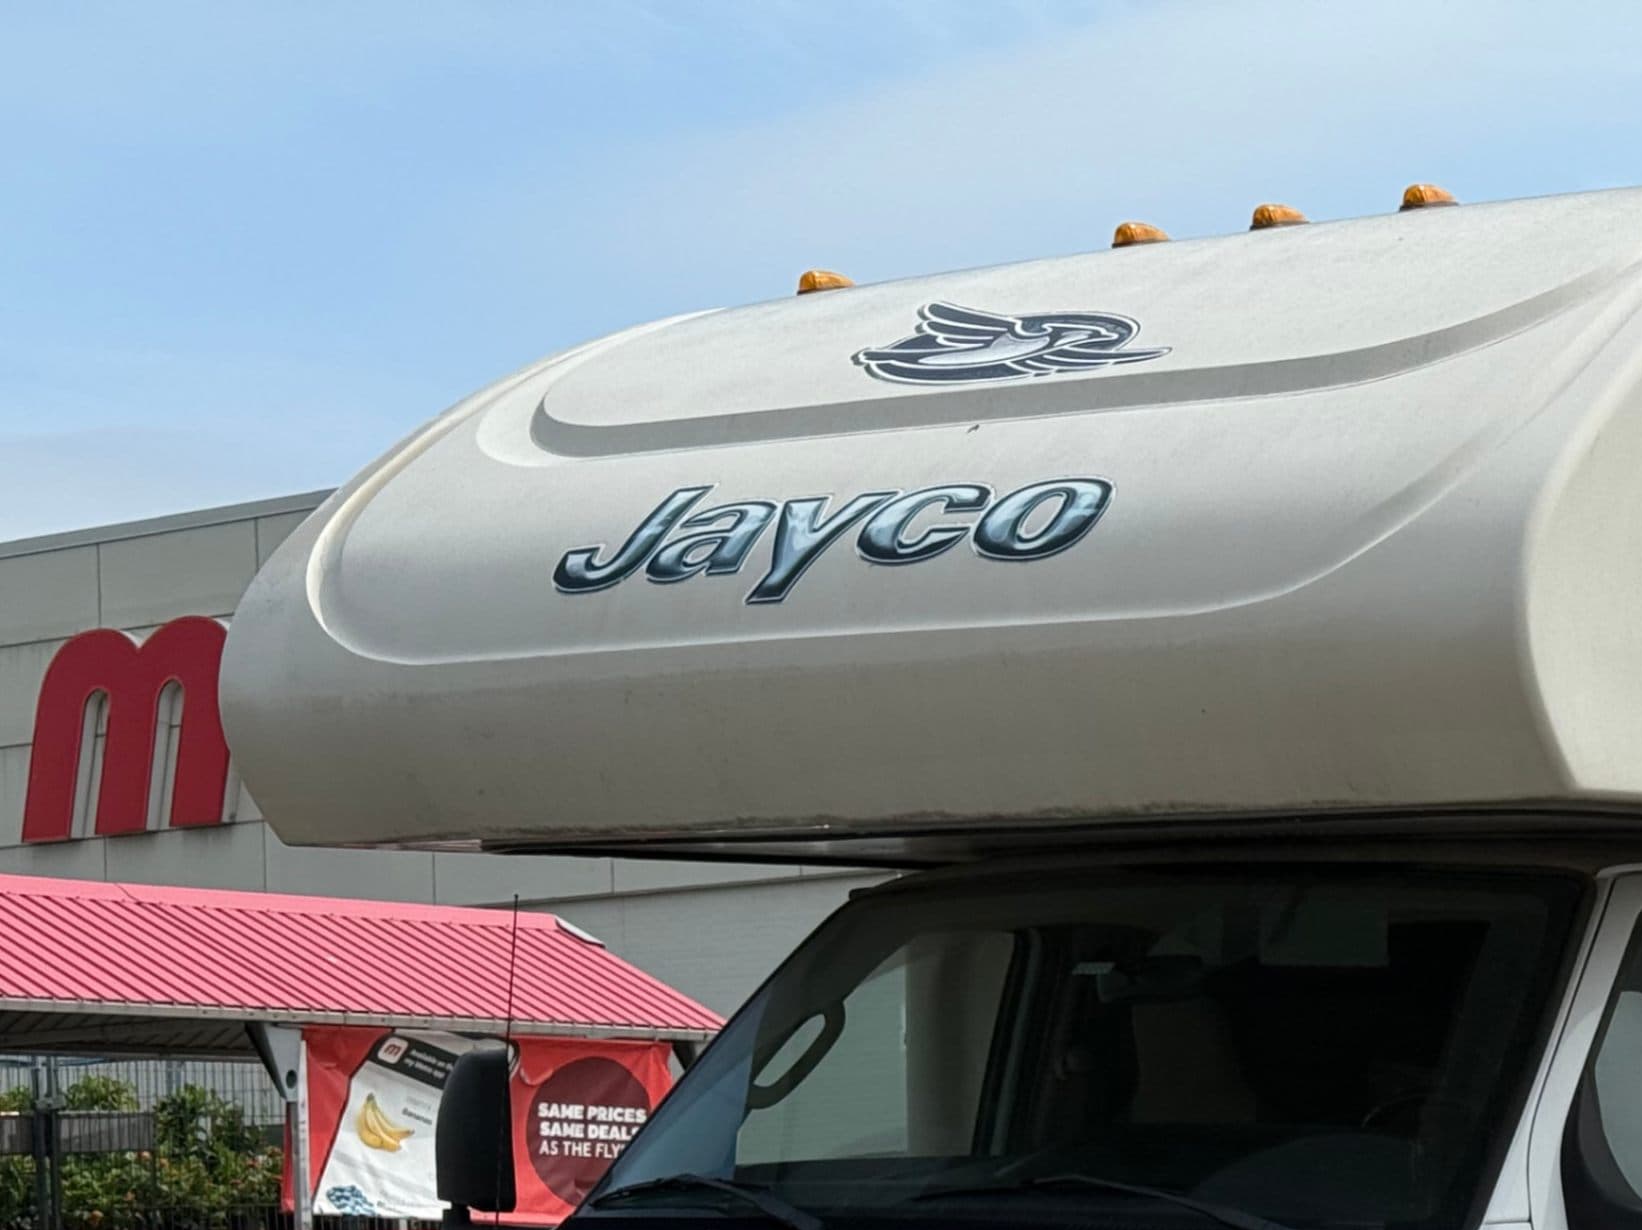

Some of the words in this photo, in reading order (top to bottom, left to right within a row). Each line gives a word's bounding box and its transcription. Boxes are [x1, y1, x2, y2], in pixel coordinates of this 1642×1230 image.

[552, 474, 1118, 605] Jayco
[538, 1102, 585, 1119] SAME
[587, 1105, 647, 1123] PRICES
[540, 1121, 585, 1138] SAME
[539, 1140, 558, 1156] AS
[563, 1141, 592, 1157] THE
[595, 1143, 626, 1159] FLY
